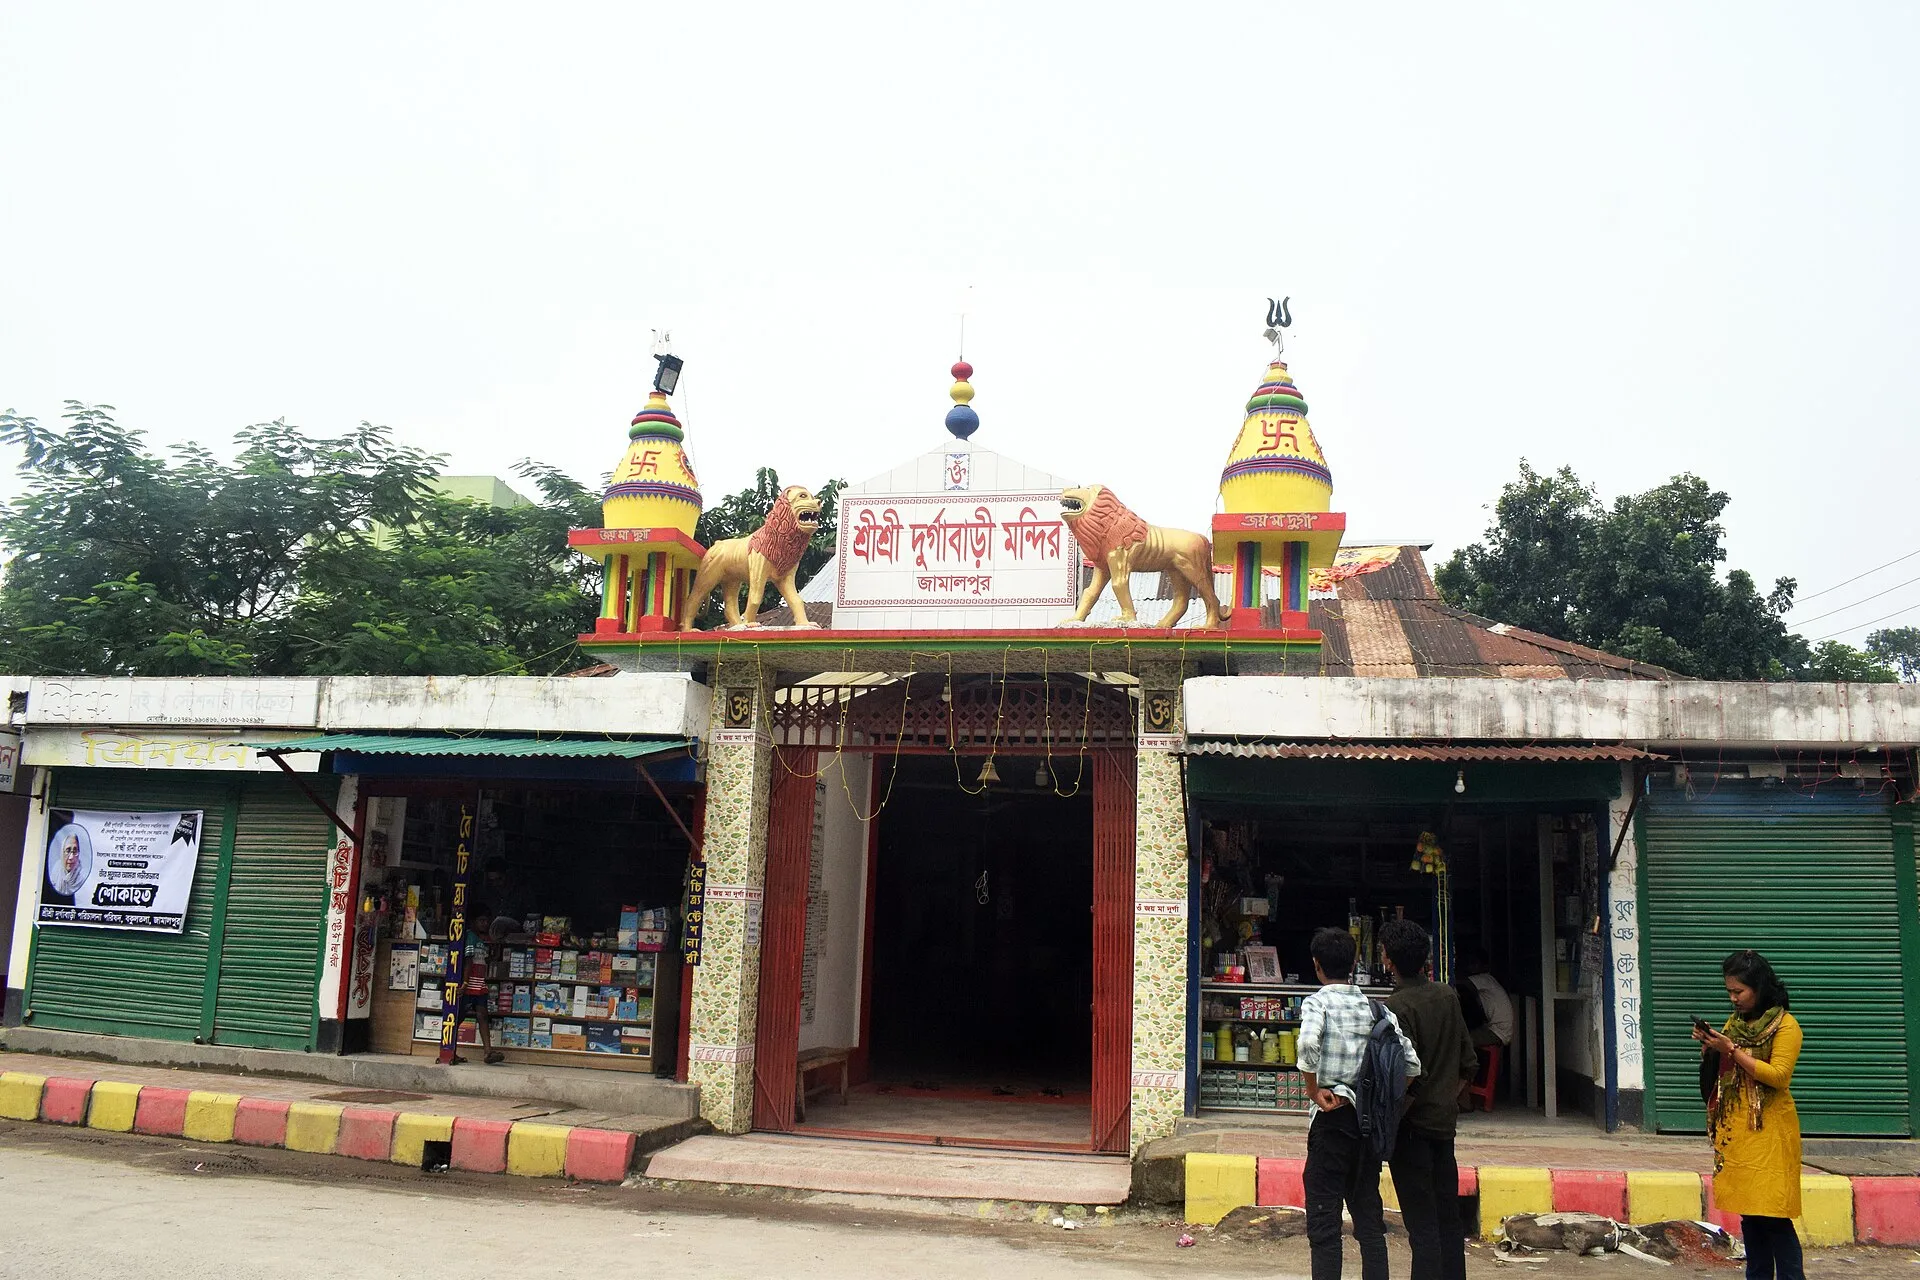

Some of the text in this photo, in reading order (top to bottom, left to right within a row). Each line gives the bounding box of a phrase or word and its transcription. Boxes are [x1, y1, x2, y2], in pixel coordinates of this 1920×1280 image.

[1269, 514, 1285, 528] মা
[909, 506, 997, 571] দুর্গাবাড়ী
[1001, 506, 1064, 561] মন্দির
[917, 573, 992, 596] জামালপুর
[98, 885, 153, 904] শোকাহত
[1614, 899, 1636, 921] বুক
[1242, 1002, 1253, 1010] UNO
[1255, 1001, 1267, 1010] UNO
[1268, 1002, 1281, 1011] UNO
